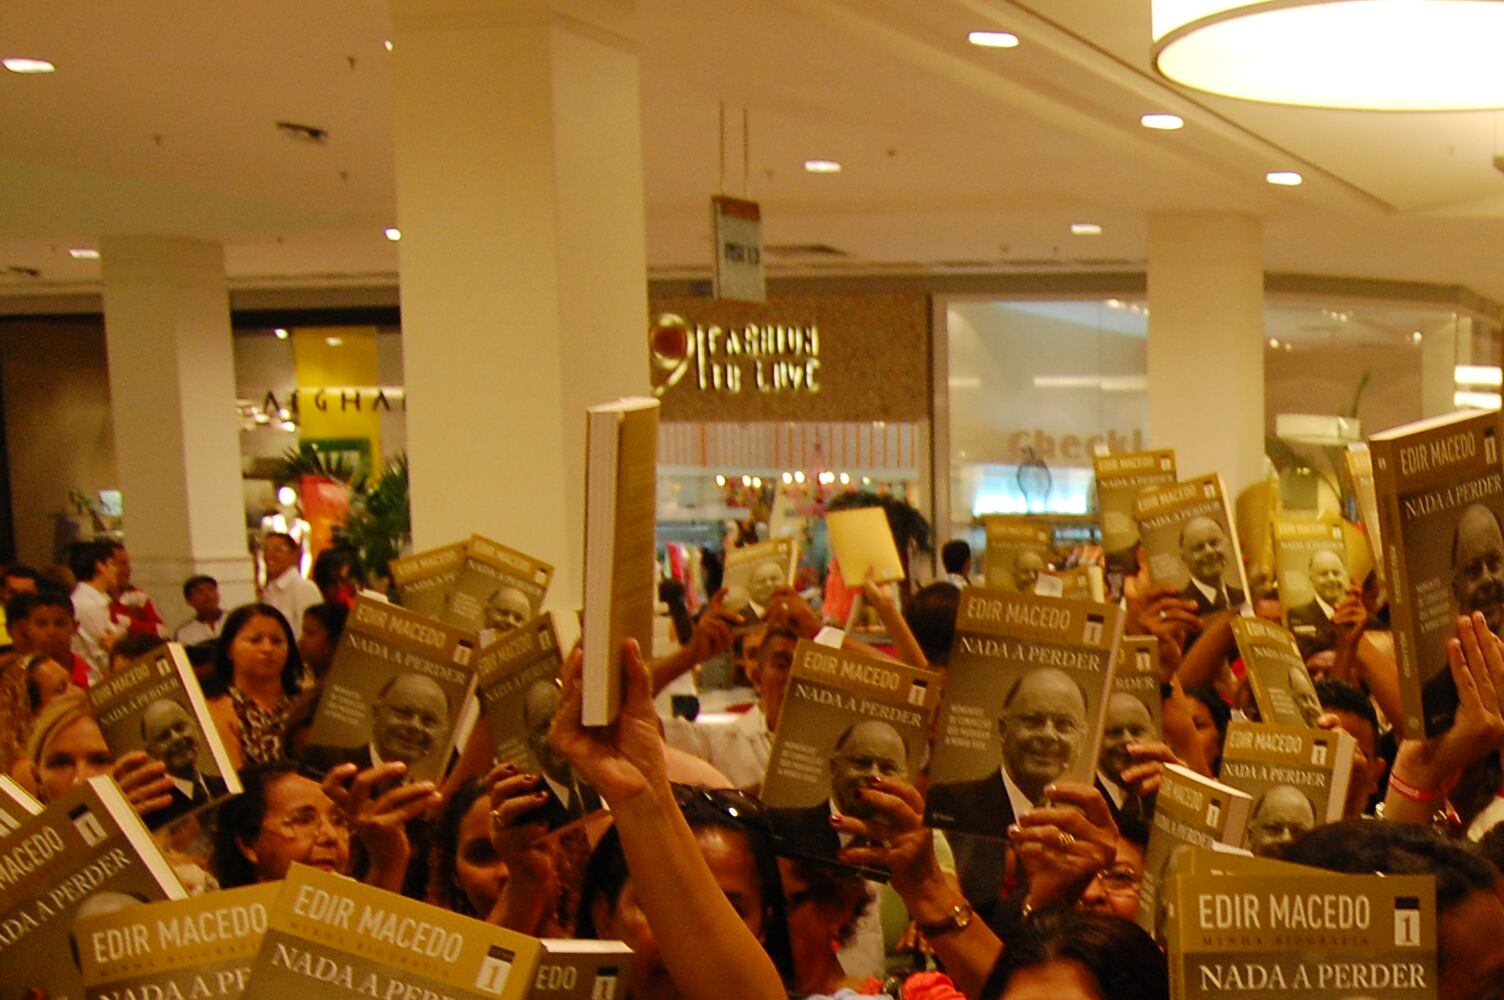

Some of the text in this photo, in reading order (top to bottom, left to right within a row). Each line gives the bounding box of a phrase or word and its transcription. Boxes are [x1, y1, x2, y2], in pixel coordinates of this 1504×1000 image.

[1400, 432, 1475, 475] EDIR MACEDO
[1405, 473, 1504, 519] NADA A PERDER
[967, 597, 1071, 631] EDIR MACEDO
[803, 652, 900, 691] EDIR MACEDO
[959, 636, 1101, 672] NADA A PERDER
[794, 682, 844, 711] NADA
[846, 697, 858, 713] A
[858, 701, 922, 728] PERDER
[1229, 729, 1303, 755] EDIR MACEDO
[1224, 762, 1326, 788] NADA A PERDER
[37, 900, 55, 922] A
[50, 847, 132, 909] PERDER
[294, 884, 464, 965] EDIR MACEDO
[1199, 893, 1371, 930] EDIR MACEDO
[1400, 914, 1414, 943] 1
[92, 902, 268, 964] EDIR MACEDO
[191, 974, 212, 999] A
[271, 942, 354, 990] NADA
[357, 972, 381, 997] A
[536, 964, 577, 991] EDO
[1200, 962, 1427, 991] NADA A PERDER
